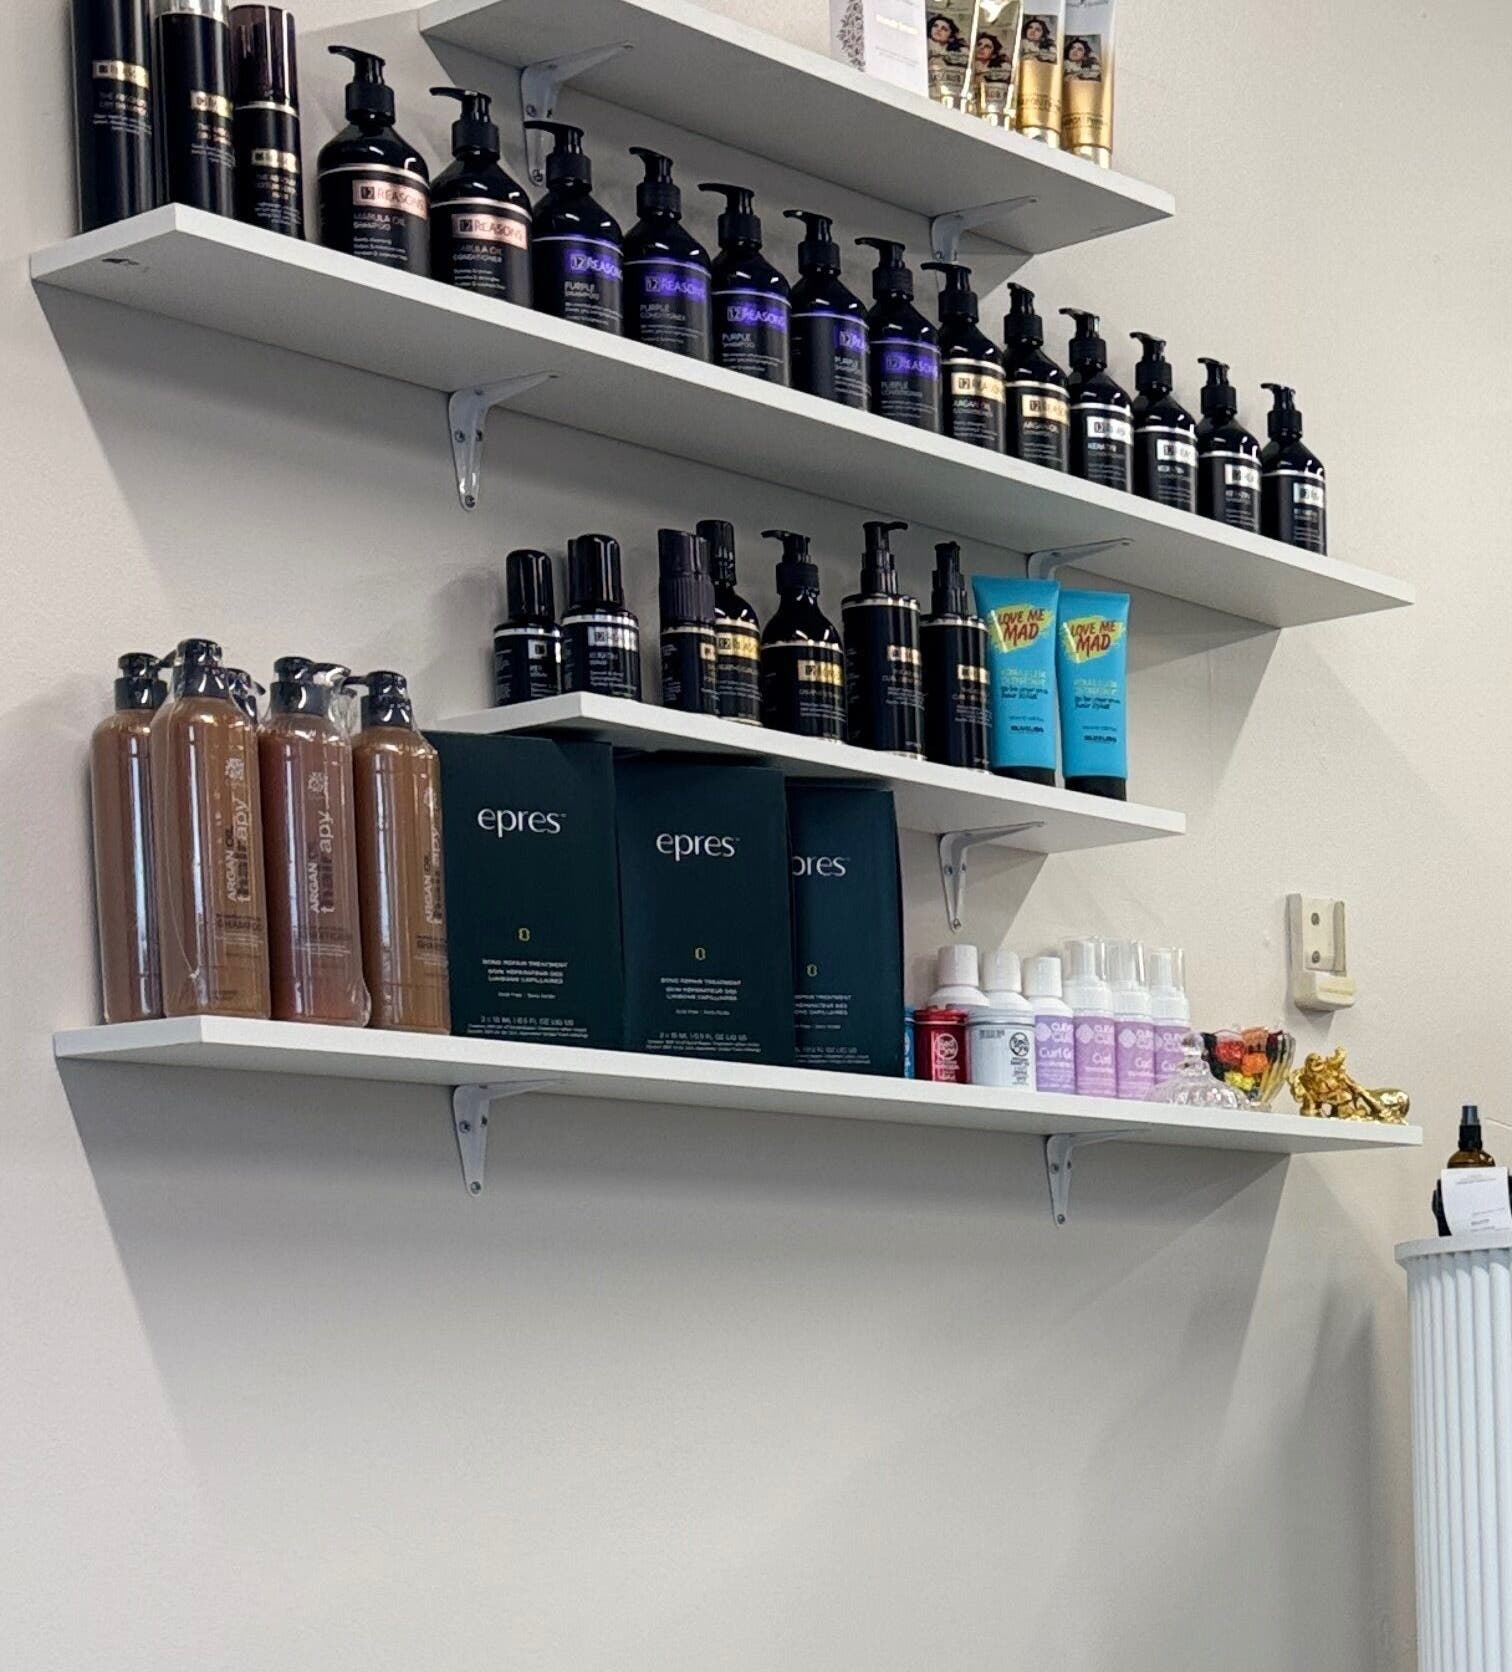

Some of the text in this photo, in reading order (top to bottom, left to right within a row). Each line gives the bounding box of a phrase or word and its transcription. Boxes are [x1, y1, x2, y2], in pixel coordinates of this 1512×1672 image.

[999, 608, 1045, 624] LOVE ME
[1004, 622, 1039, 646] MAD
[1071, 621, 1116, 637] LOVE ME
[1076, 633, 1111, 658] MAD
[477, 807, 562, 838] epres
[656, 832, 737, 862] epres
[225, 851, 238, 901] ARGAN
[792, 855, 847, 878] pres
[309, 863, 320, 913] ARGAN
